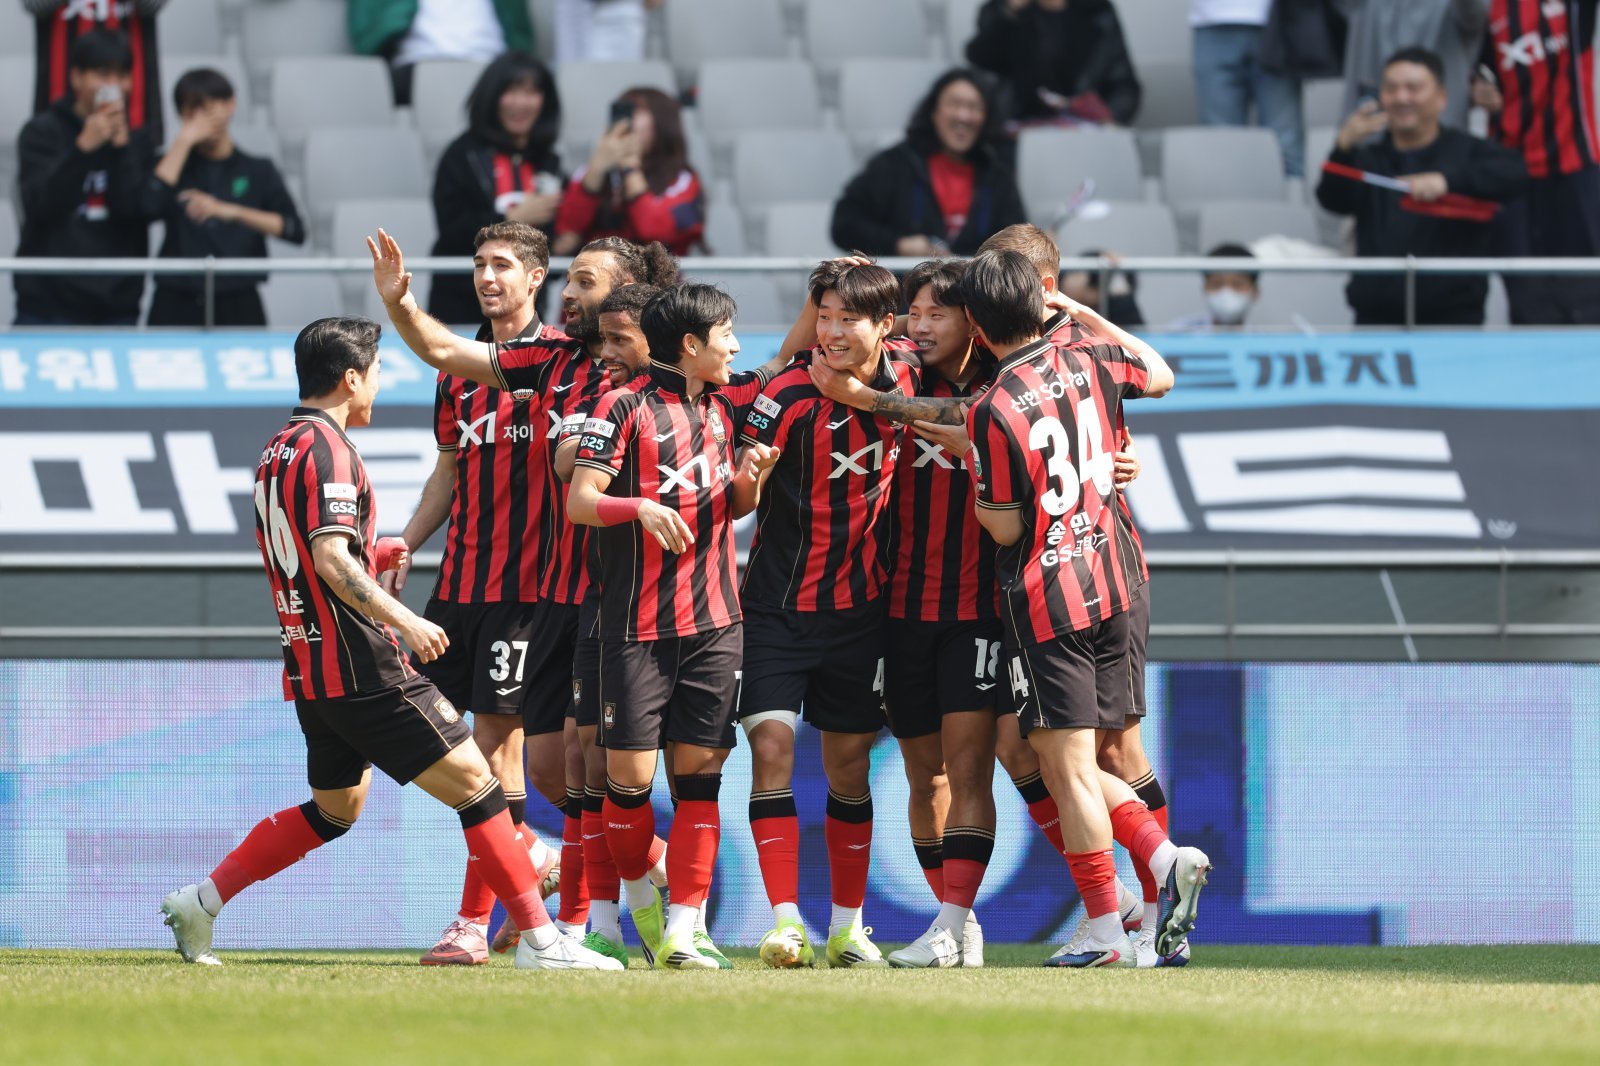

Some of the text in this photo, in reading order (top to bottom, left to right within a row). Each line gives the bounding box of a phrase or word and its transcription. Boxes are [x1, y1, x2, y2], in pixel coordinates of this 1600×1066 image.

[503, 424, 533, 442] 자이
[1029, 396, 1114, 516] 34
[254, 476, 300, 579] 16
[1047, 505, 1105, 546] 송민
[489, 641, 529, 681] 37
[1007, 655, 1030, 702] 4
